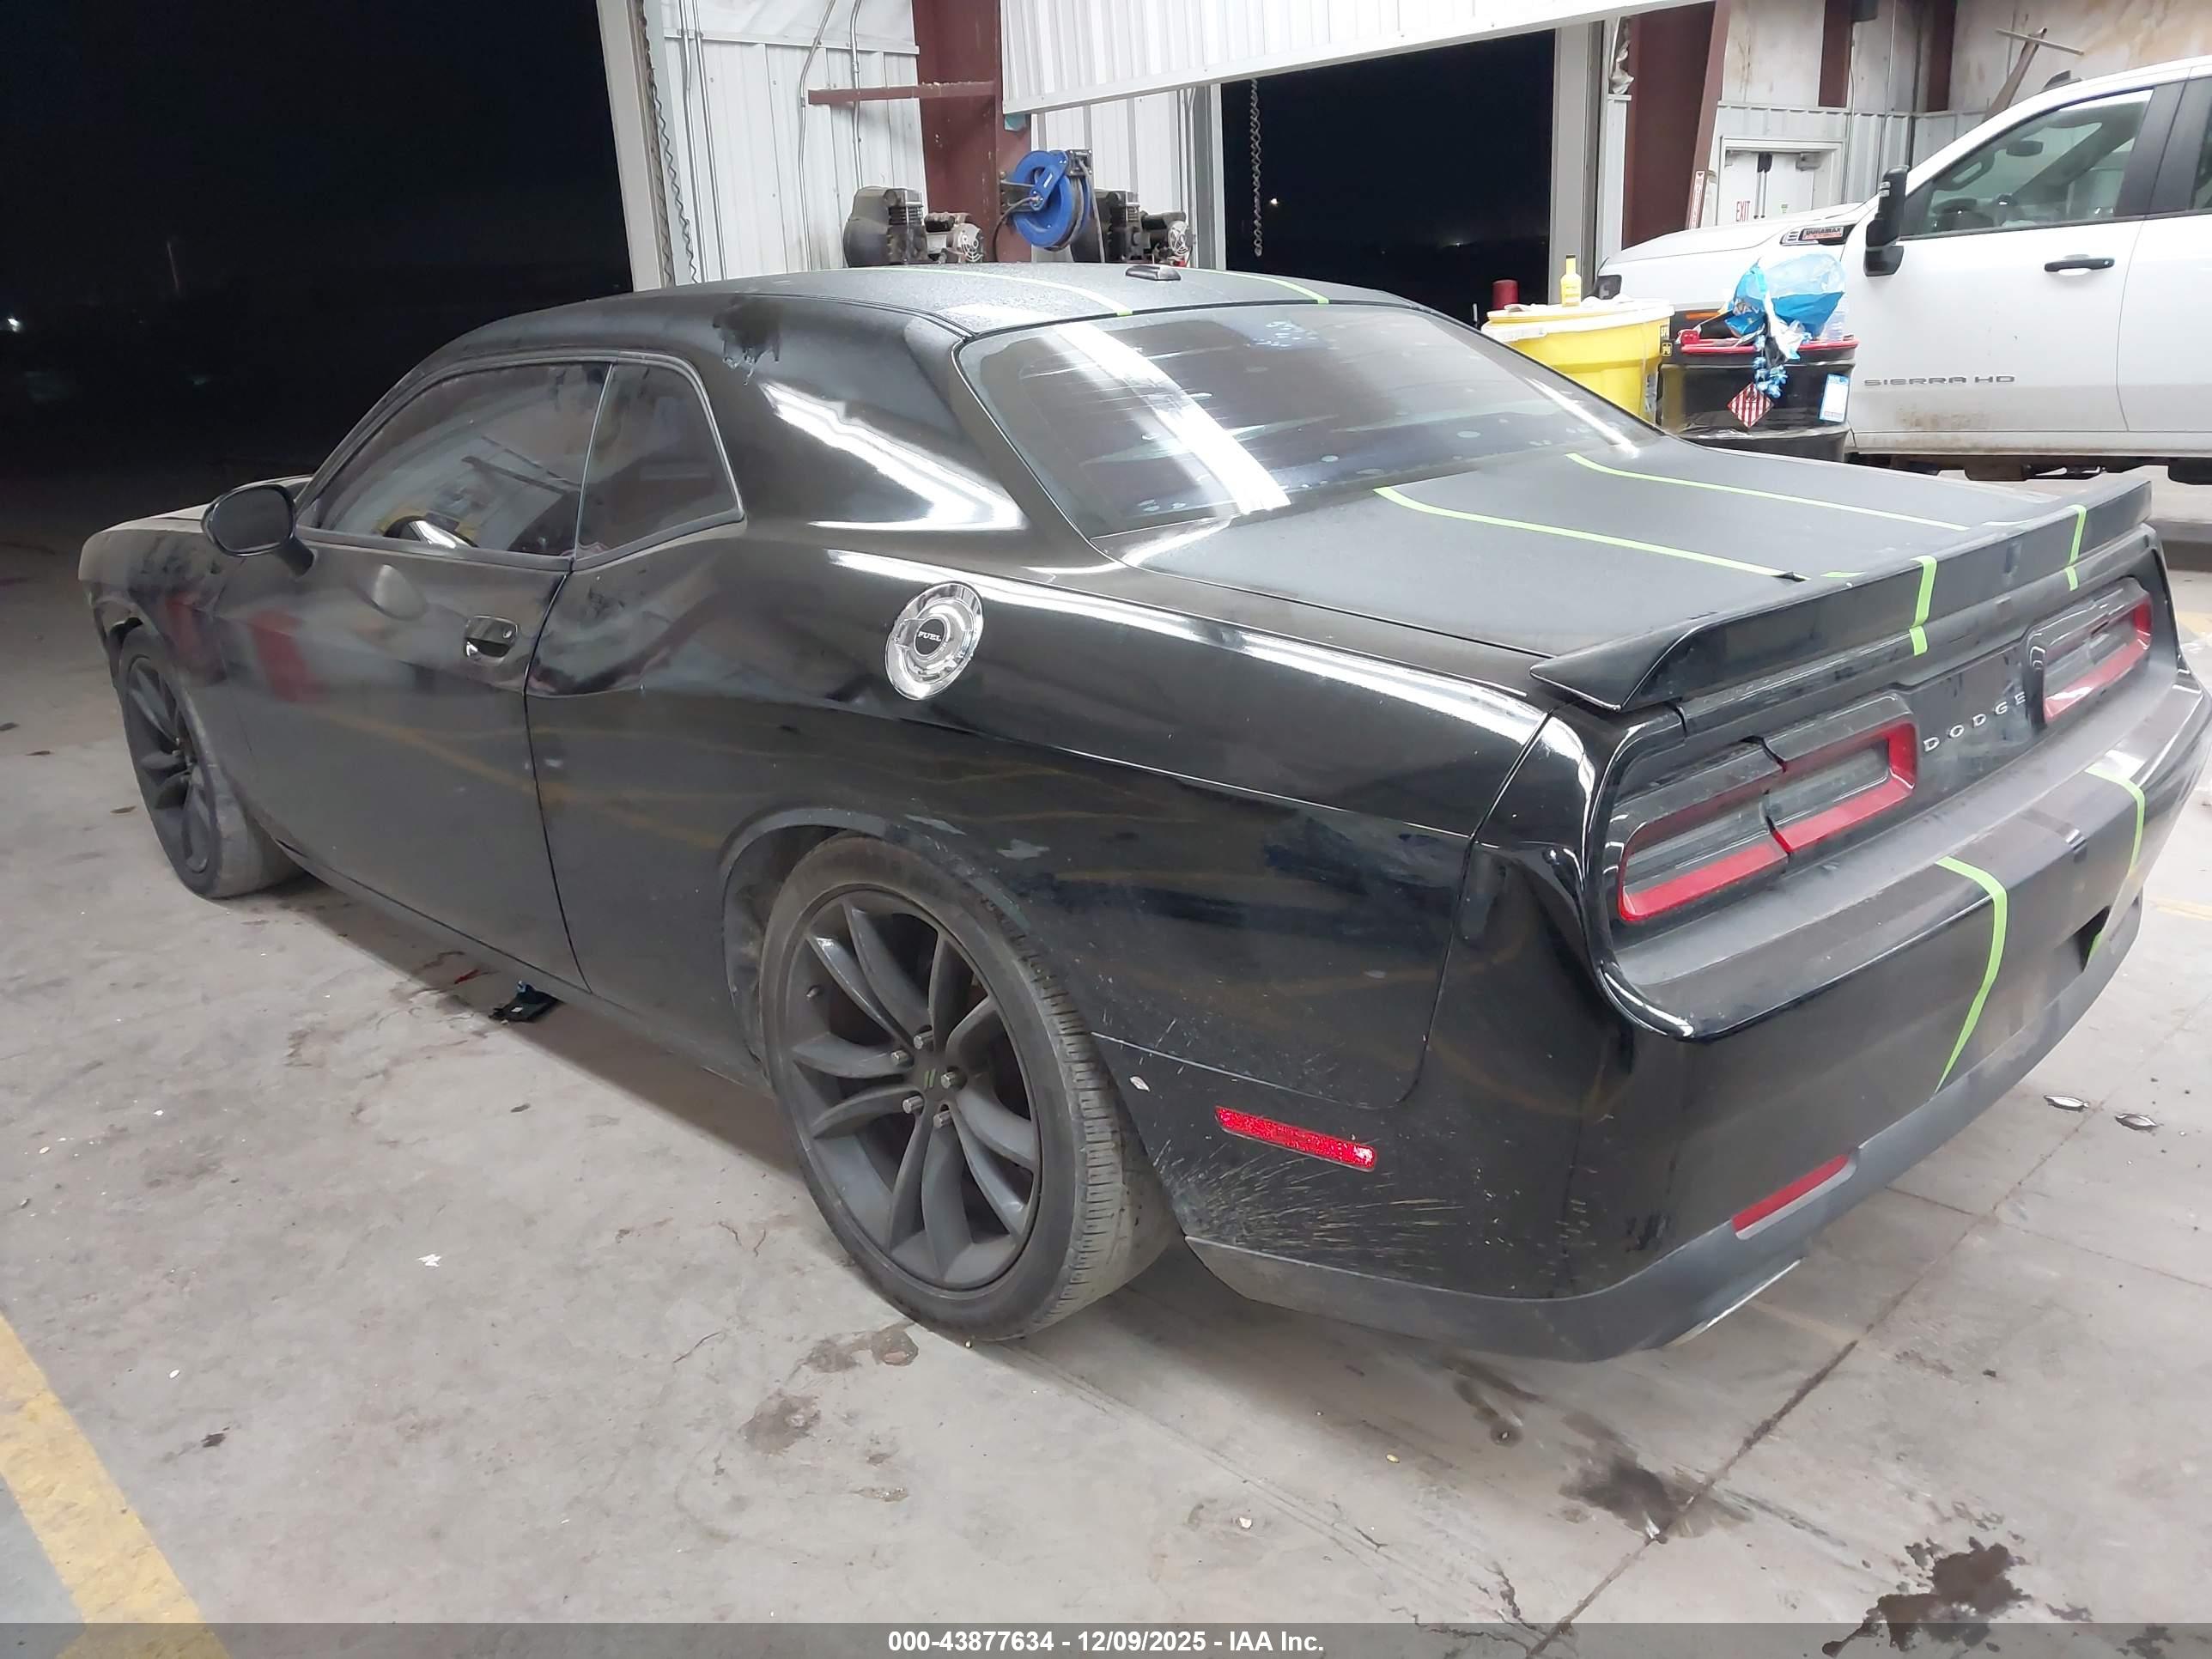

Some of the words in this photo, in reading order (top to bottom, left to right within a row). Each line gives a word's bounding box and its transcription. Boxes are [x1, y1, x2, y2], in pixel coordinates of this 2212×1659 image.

[1735, 200, 1751, 222] EXIT
[1864, 376, 1967, 386] SIERRA
[1974, 375, 2015, 384] HD
[917, 631, 942, 642] FUEL
[1923, 691, 2027, 752] DODGE
